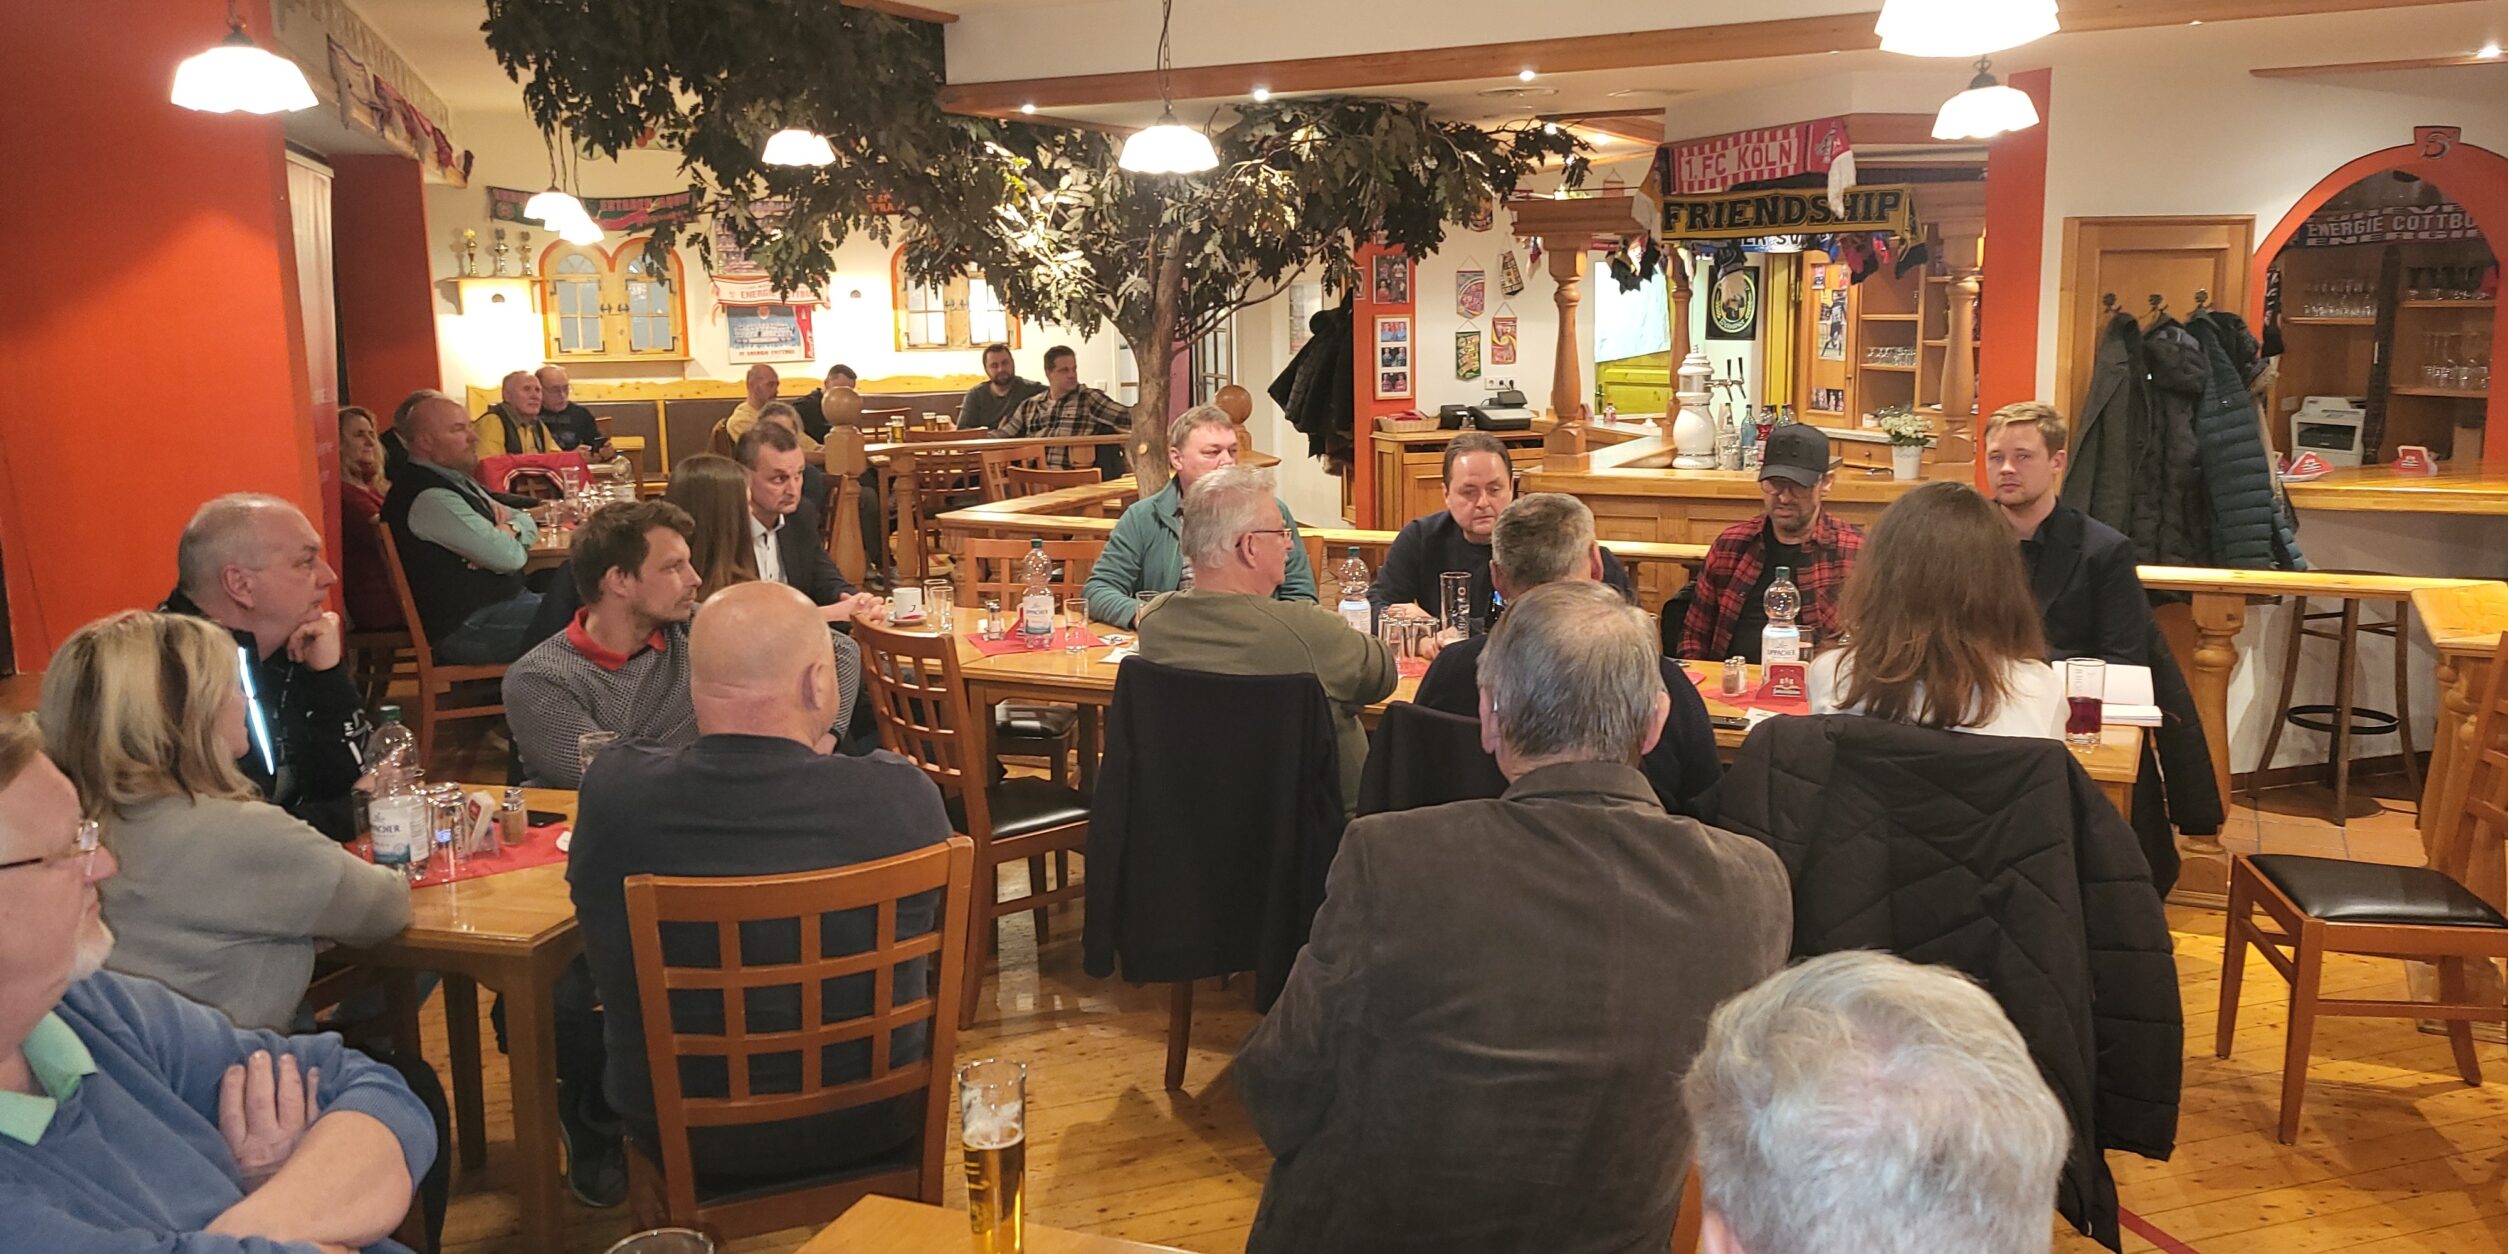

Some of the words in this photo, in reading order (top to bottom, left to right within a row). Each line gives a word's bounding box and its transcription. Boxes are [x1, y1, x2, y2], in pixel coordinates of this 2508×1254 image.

[1663, 190, 1900, 233] FRIENDSHIP
[2307, 216, 2383, 237] ENERGIE
[2393, 212, 2477, 231] COTTBU
